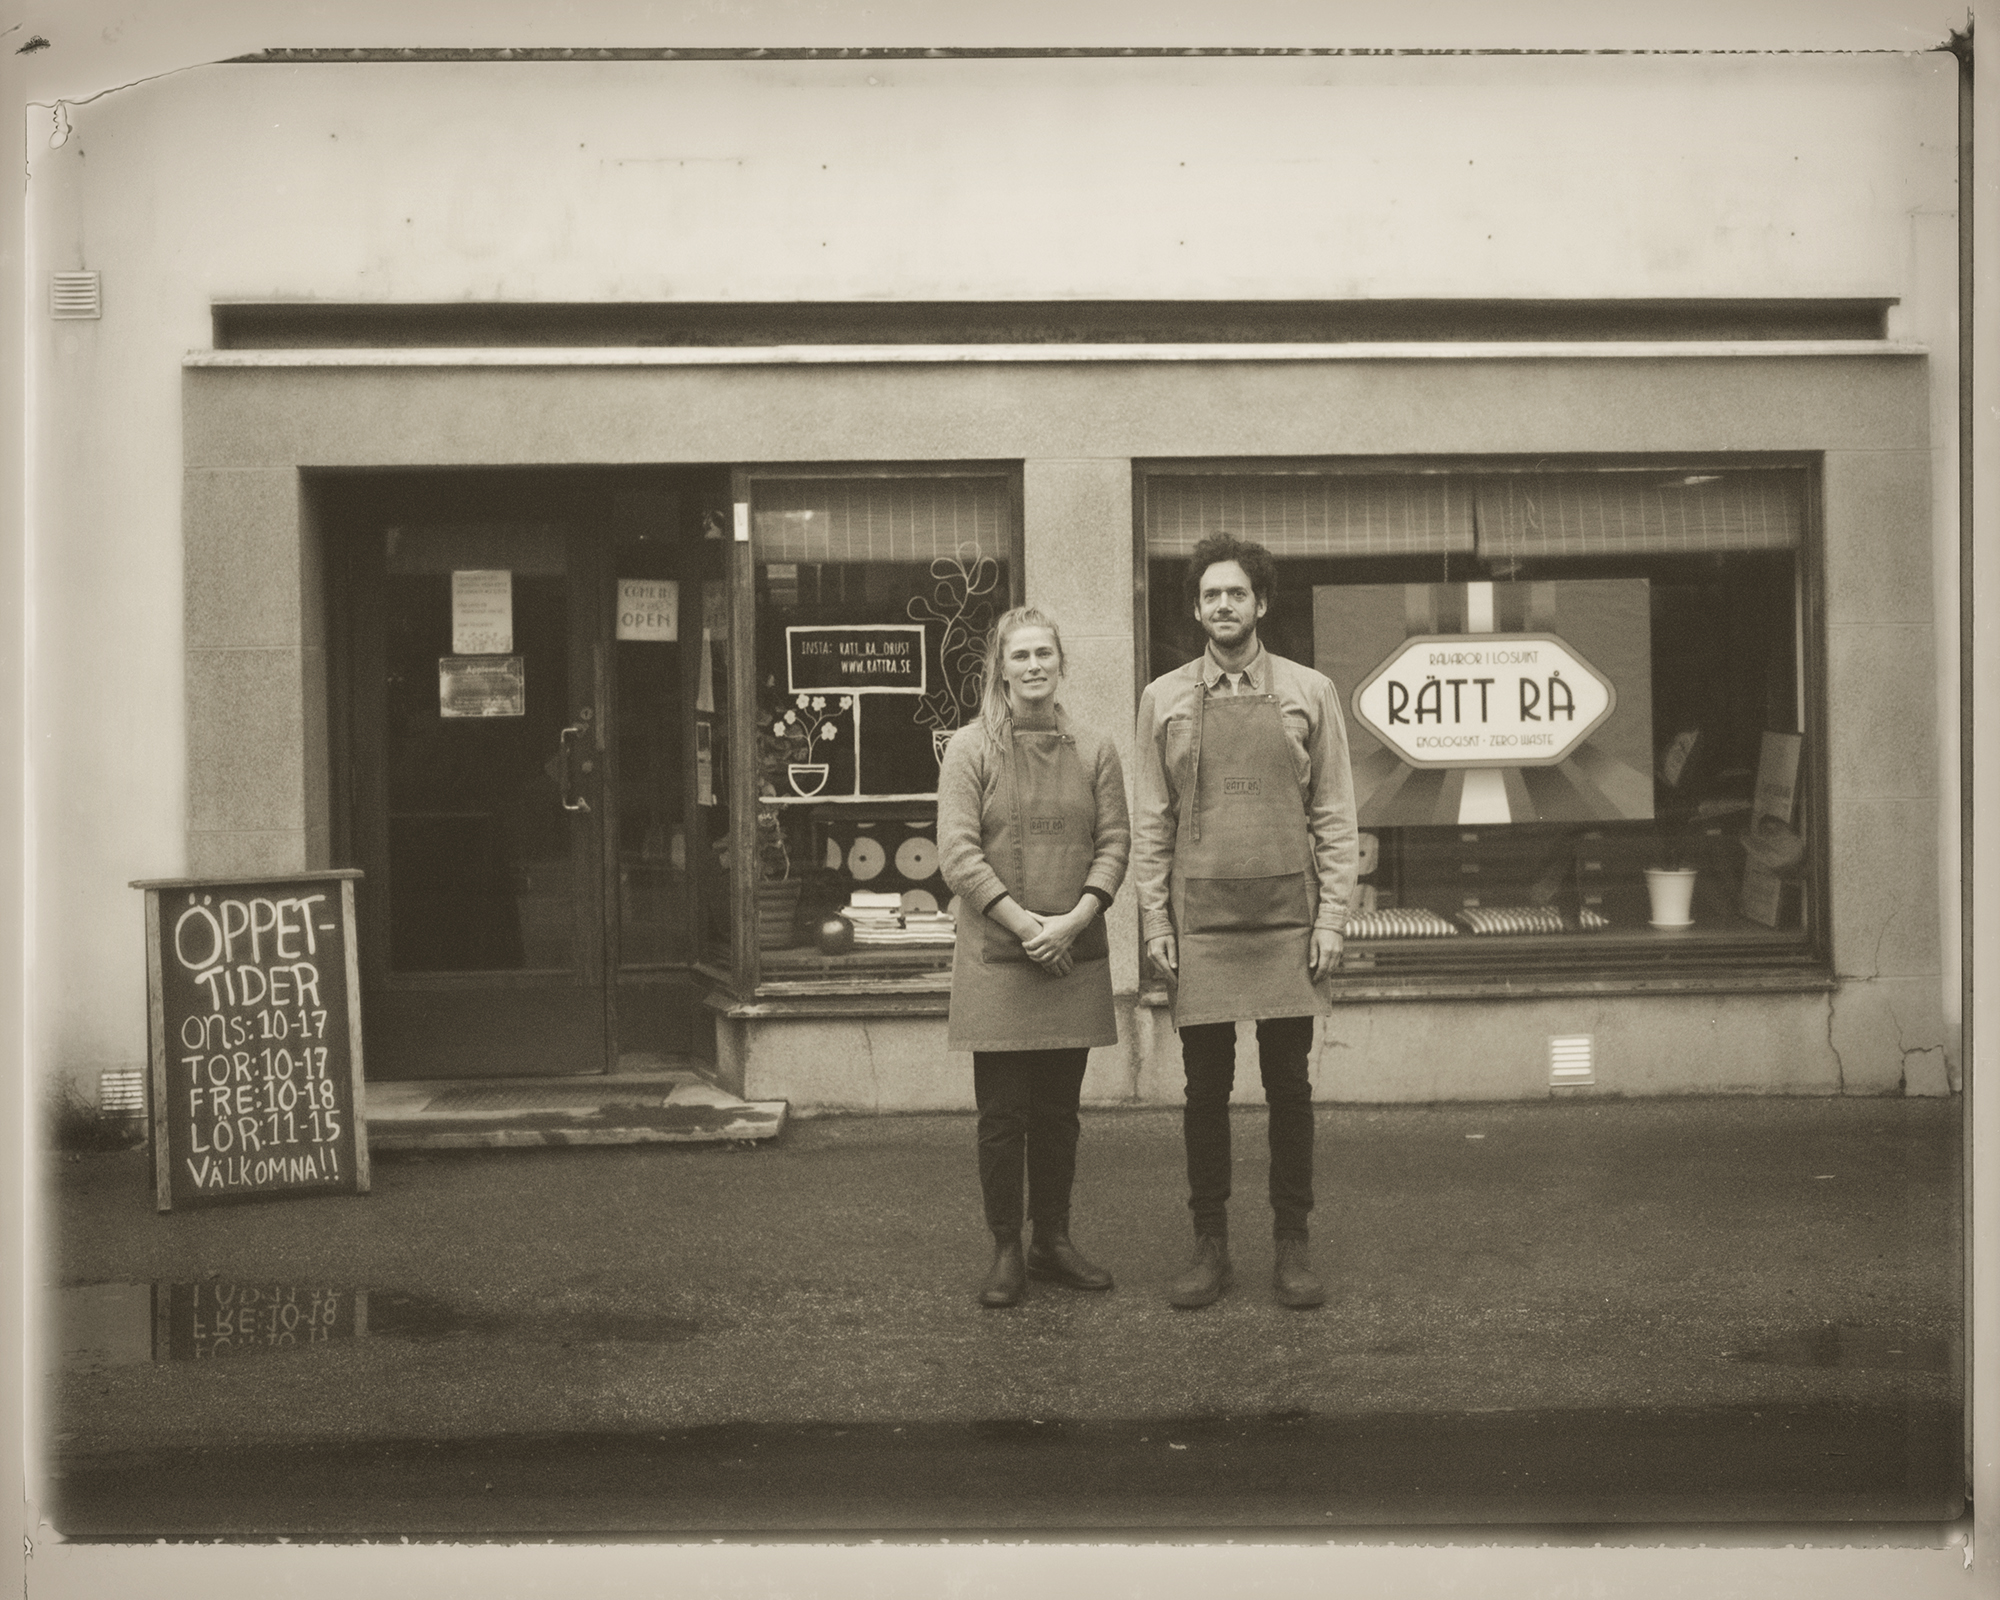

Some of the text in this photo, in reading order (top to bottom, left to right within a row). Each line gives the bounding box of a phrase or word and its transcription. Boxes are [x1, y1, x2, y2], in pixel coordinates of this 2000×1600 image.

[621, 612, 671, 628] OPEN
[801, 641, 833, 655] INSTA:
[1485, 651, 1490, 665] I
[841, 659, 911, 674] WWW.RATTRA.SE
[1388, 670, 1576, 725] RÄTT RÅ
[1416, 733, 1554, 748] EKOLOGISKT ZERO WASTE
[175, 893, 335, 970] ÖPPET-
[195, 962, 320, 1011] TIDER
[186, 1146, 339, 1188] VÄLKOMNA!!
